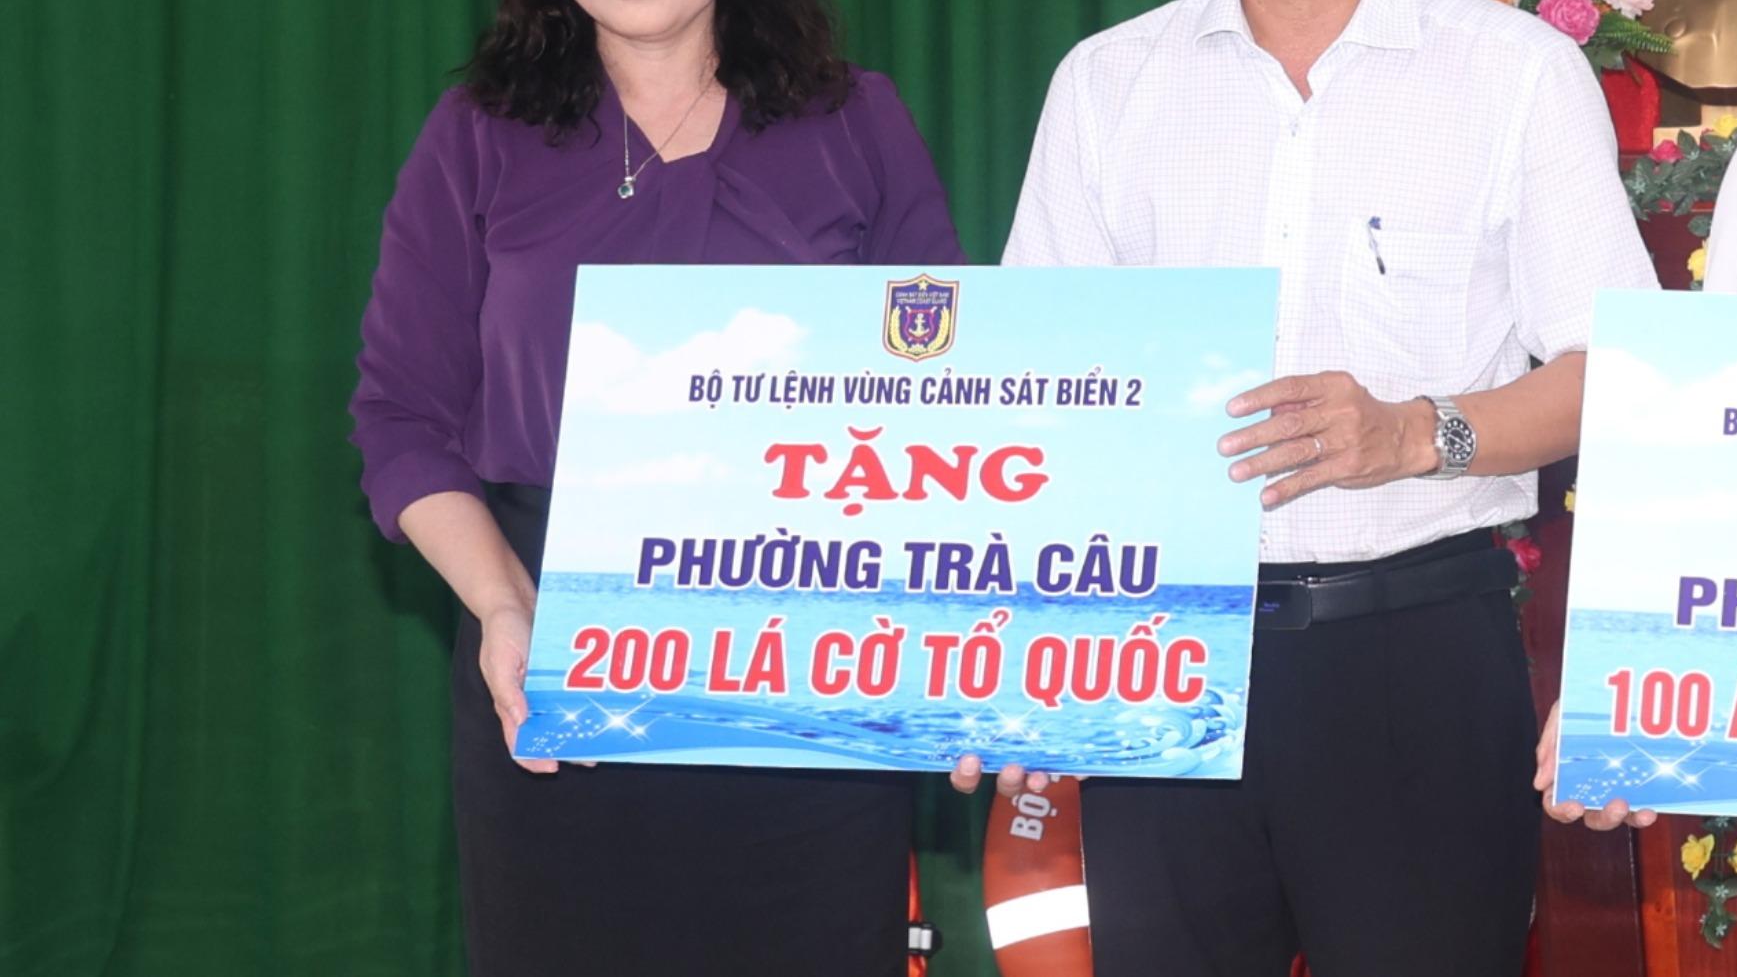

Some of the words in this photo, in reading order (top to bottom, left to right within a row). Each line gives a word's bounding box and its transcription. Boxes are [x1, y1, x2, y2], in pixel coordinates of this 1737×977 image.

[689, 369, 722, 409] BỘ
[732, 373, 765, 402] TƯ
[770, 370, 835, 409] LỆNH
[844, 371, 911, 404] VÙNG
[920, 367, 991, 405] CẢNH
[999, 372, 1049, 405] SÁT
[1056, 367, 1118, 406] BIỂN
[1125, 379, 1141, 406] 2
[763, 427, 1049, 517] TẶNG
[637, 528, 882, 589] PHƯỜNG
[904, 533, 1013, 591] TRÀ
[1036, 534, 1158, 594] CÂU
[566, 627, 689, 692] 200
[708, 617, 786, 694] LÁ
[811, 617, 906, 697] CỜ
[923, 609, 1009, 700] TỔ
[1025, 615, 1207, 708] QUỐC
[1607, 670, 1712, 738] 100
[1009, 793, 1058, 841] BỘ
